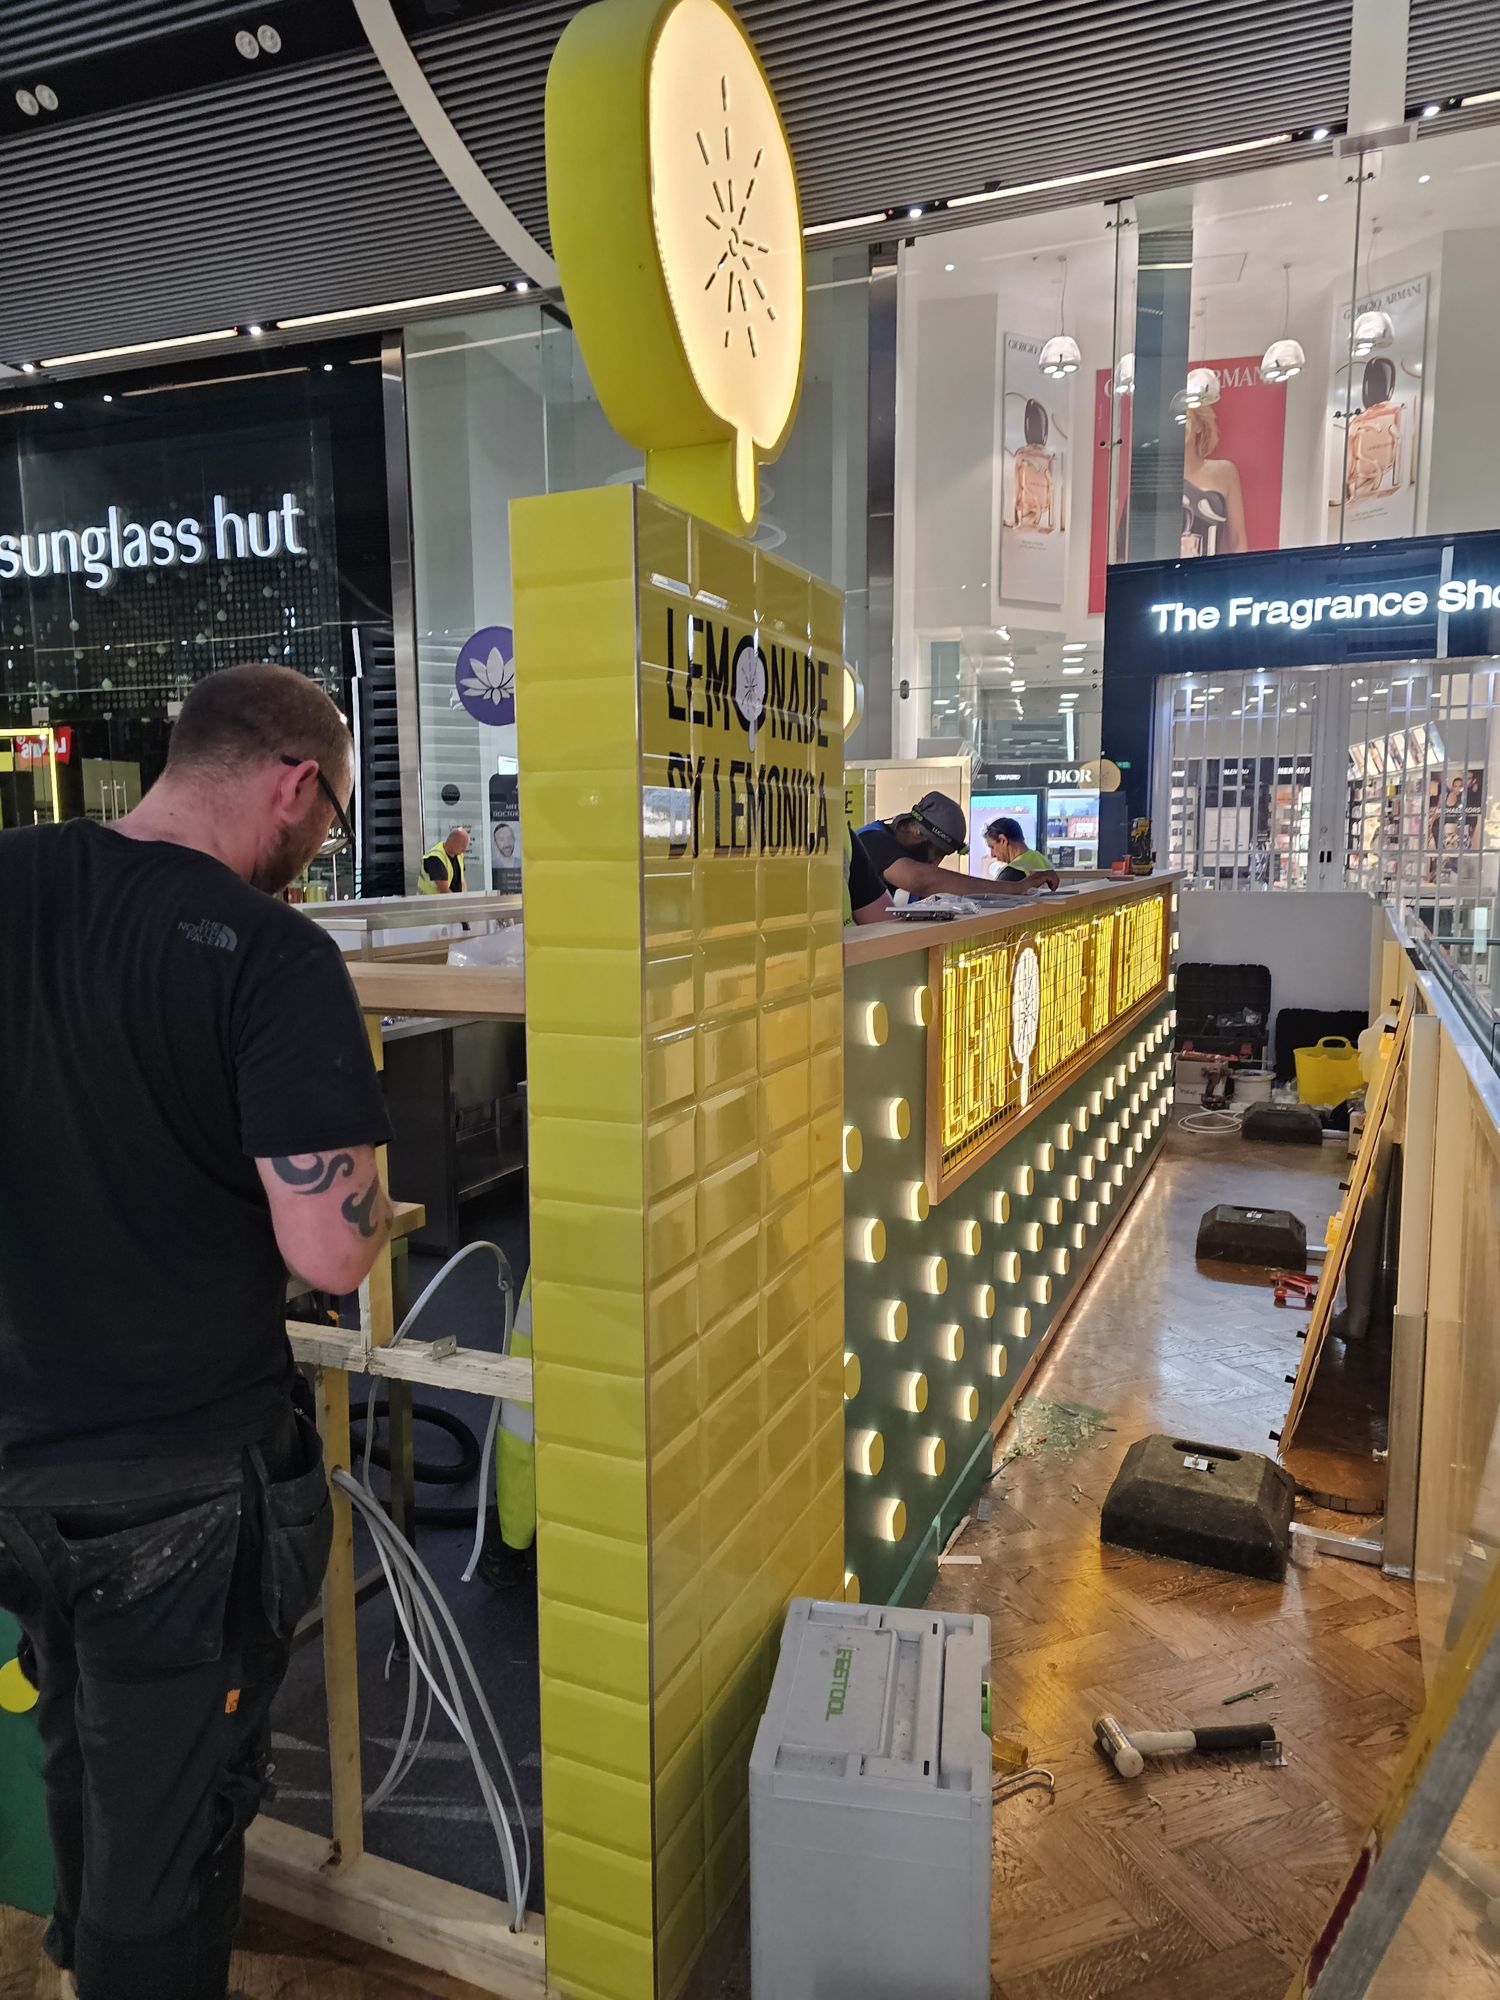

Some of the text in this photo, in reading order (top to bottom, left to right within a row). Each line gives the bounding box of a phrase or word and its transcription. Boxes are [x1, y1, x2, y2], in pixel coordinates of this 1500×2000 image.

[0, 493, 307, 590] sunglass hut
[1151, 602, 1221, 633] The
[1228, 591, 1428, 630] Fragrance
[667, 608, 829, 748] LEMONADE
[714, 757, 829, 857] LEMONICA
[1048, 769, 1092, 784] DIOR
[825, 1648, 852, 1721] FESTOOL
